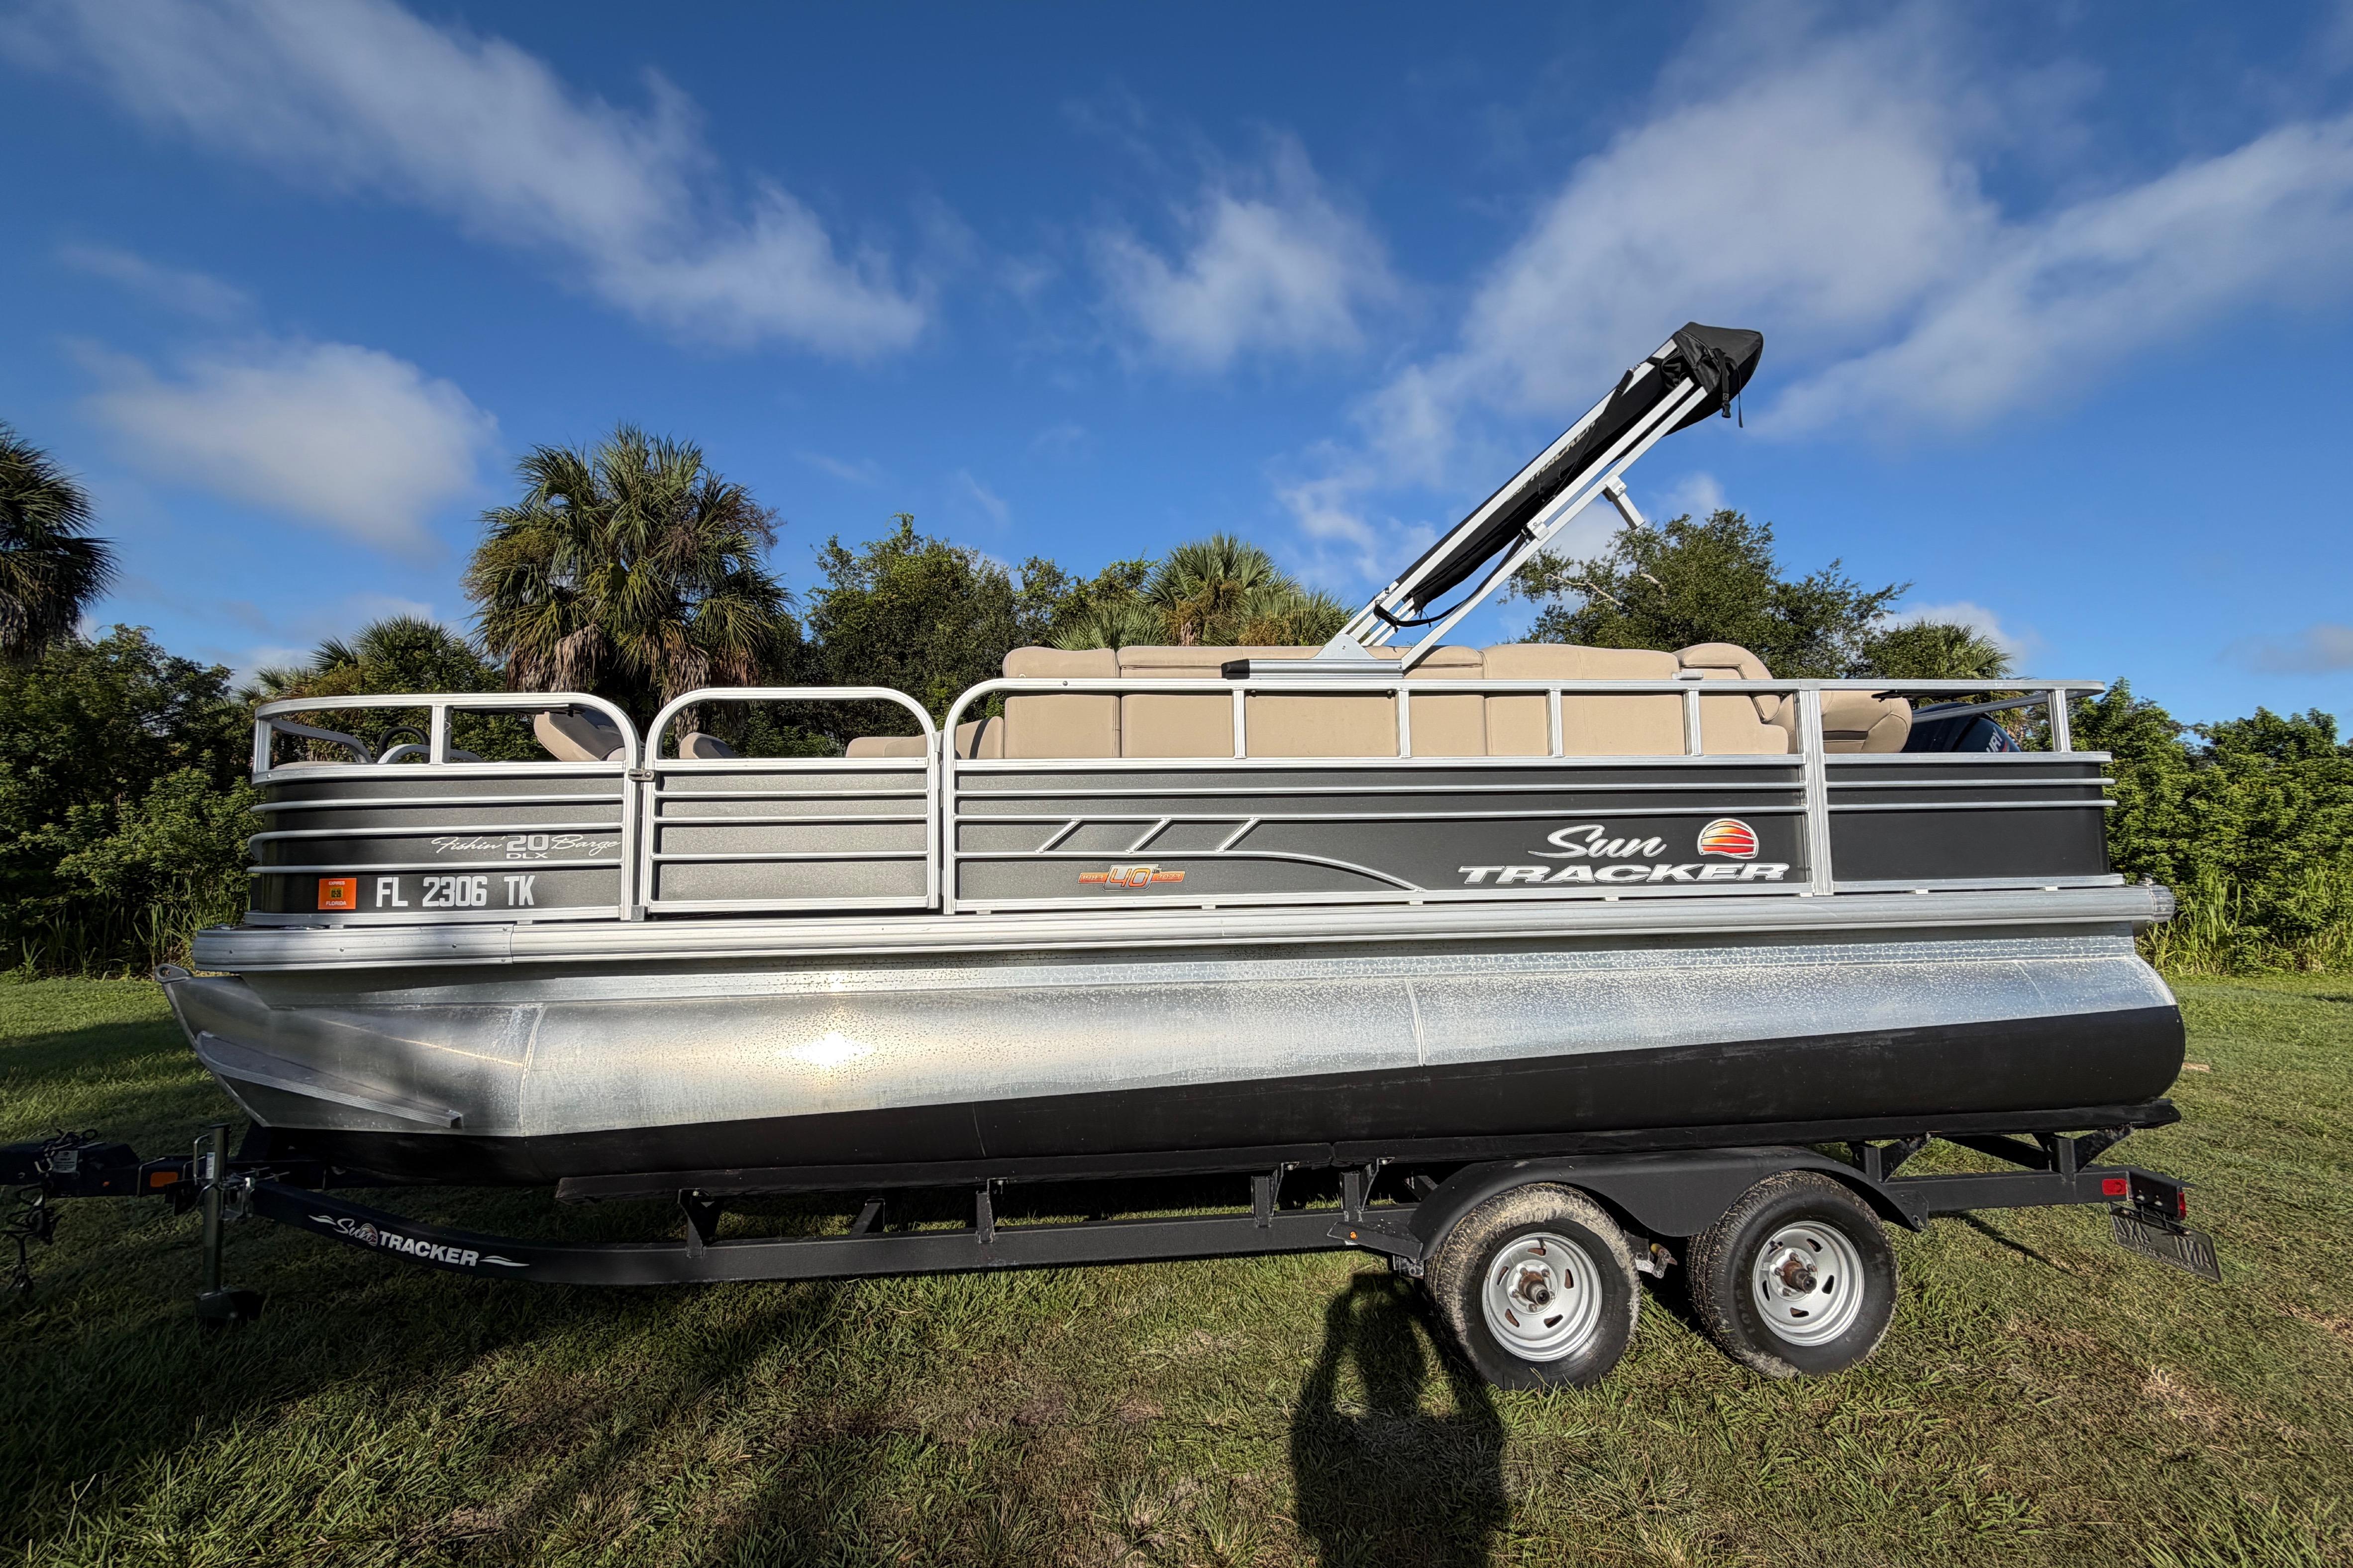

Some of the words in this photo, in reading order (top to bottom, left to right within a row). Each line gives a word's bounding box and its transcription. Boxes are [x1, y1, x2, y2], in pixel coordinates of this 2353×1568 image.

[507, 834, 549, 852] 20
[551, 834, 621, 856] Barge
[1528, 824, 1666, 858] Sun
[1458, 863, 1790, 884] TRACKER
[376, 877, 408, 907] FL
[422, 876, 488, 907] 2306
[504, 876, 535, 905] TK
[332, 1218, 376, 1243] Sun
[379, 1230, 479, 1267] TRACKER
